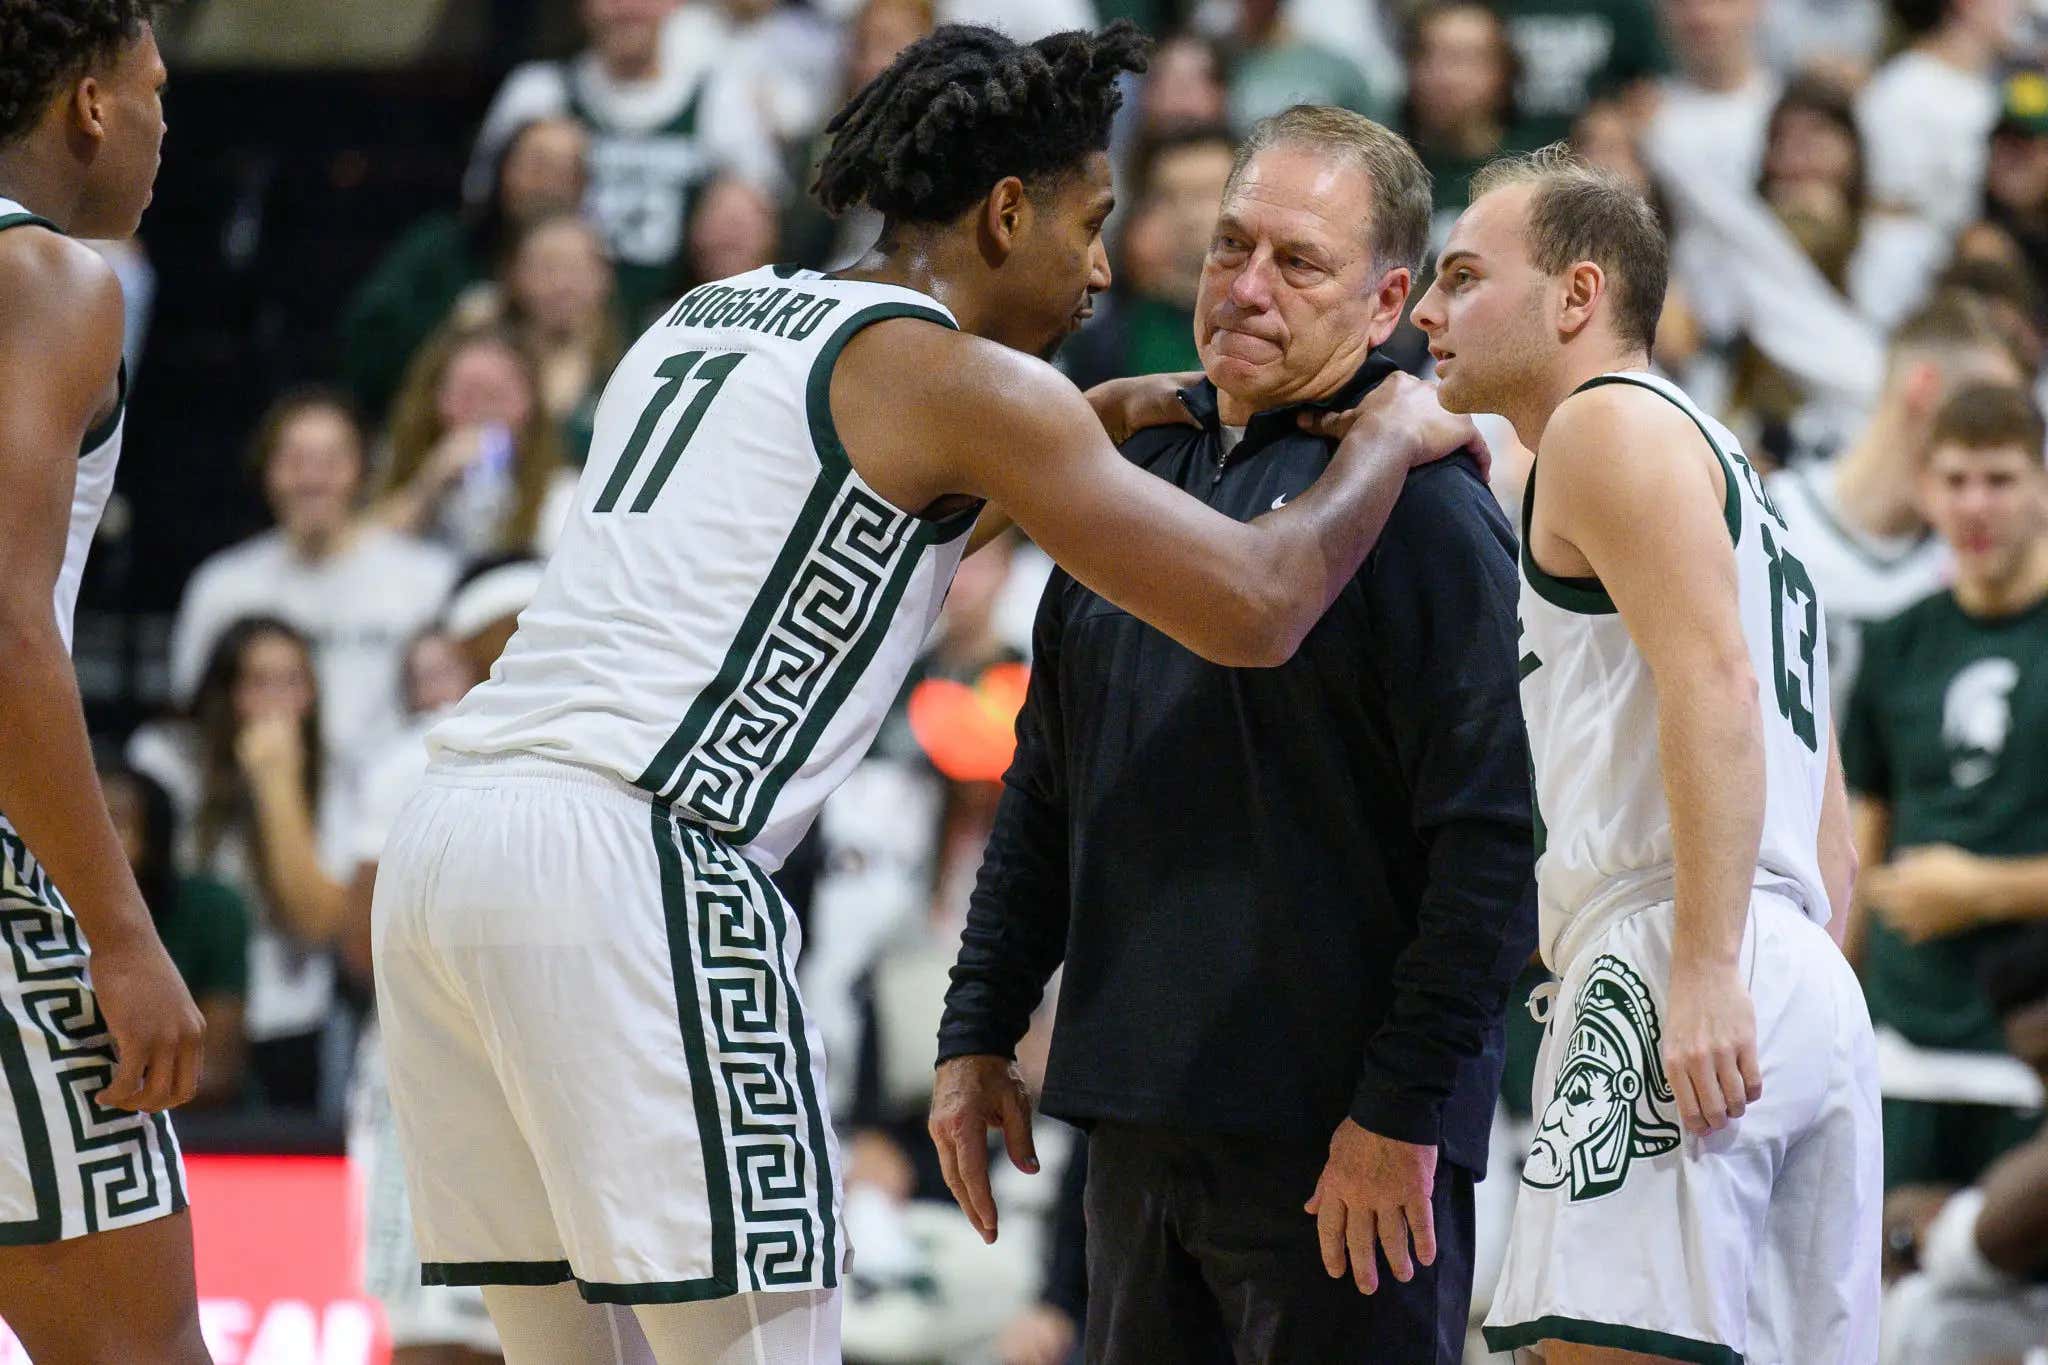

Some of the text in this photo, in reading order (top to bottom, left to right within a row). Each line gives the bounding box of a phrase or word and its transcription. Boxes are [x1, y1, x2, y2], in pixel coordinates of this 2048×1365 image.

[665, 284, 842, 342] HOGGARD
[592, 350, 748, 513] 11
[1760, 522, 1818, 753] 13
